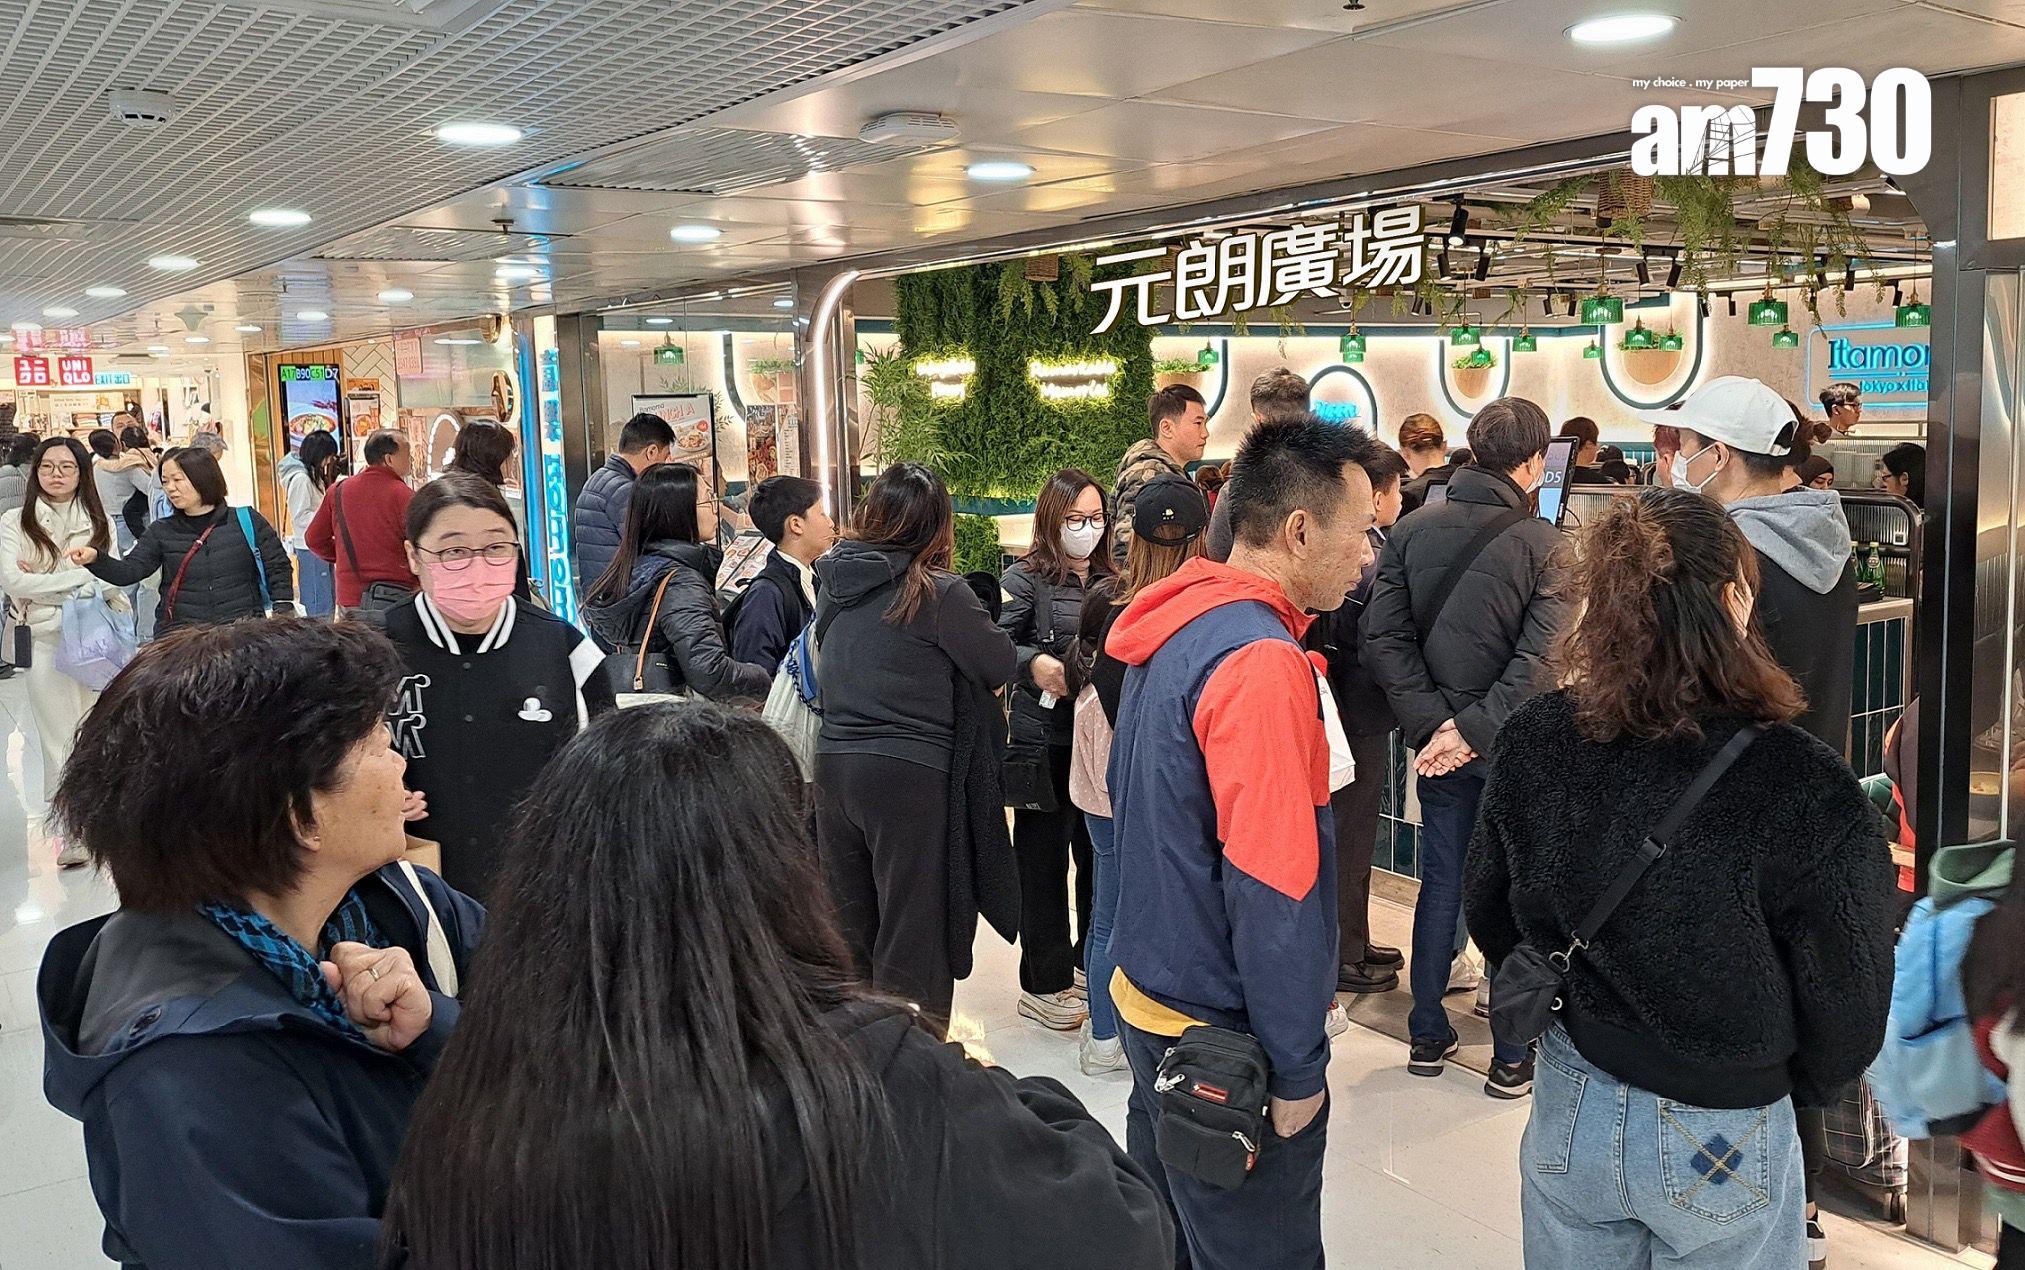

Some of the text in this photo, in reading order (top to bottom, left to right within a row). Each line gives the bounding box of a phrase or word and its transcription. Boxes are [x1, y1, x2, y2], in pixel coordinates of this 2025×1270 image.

[1089, 205, 1424, 335] 元朗廣場
[61, 359, 88, 371] UNI
[62, 371, 91, 384] QLO
[95, 374, 112, 385] EXIT
[115, 374, 130, 385] 出口
